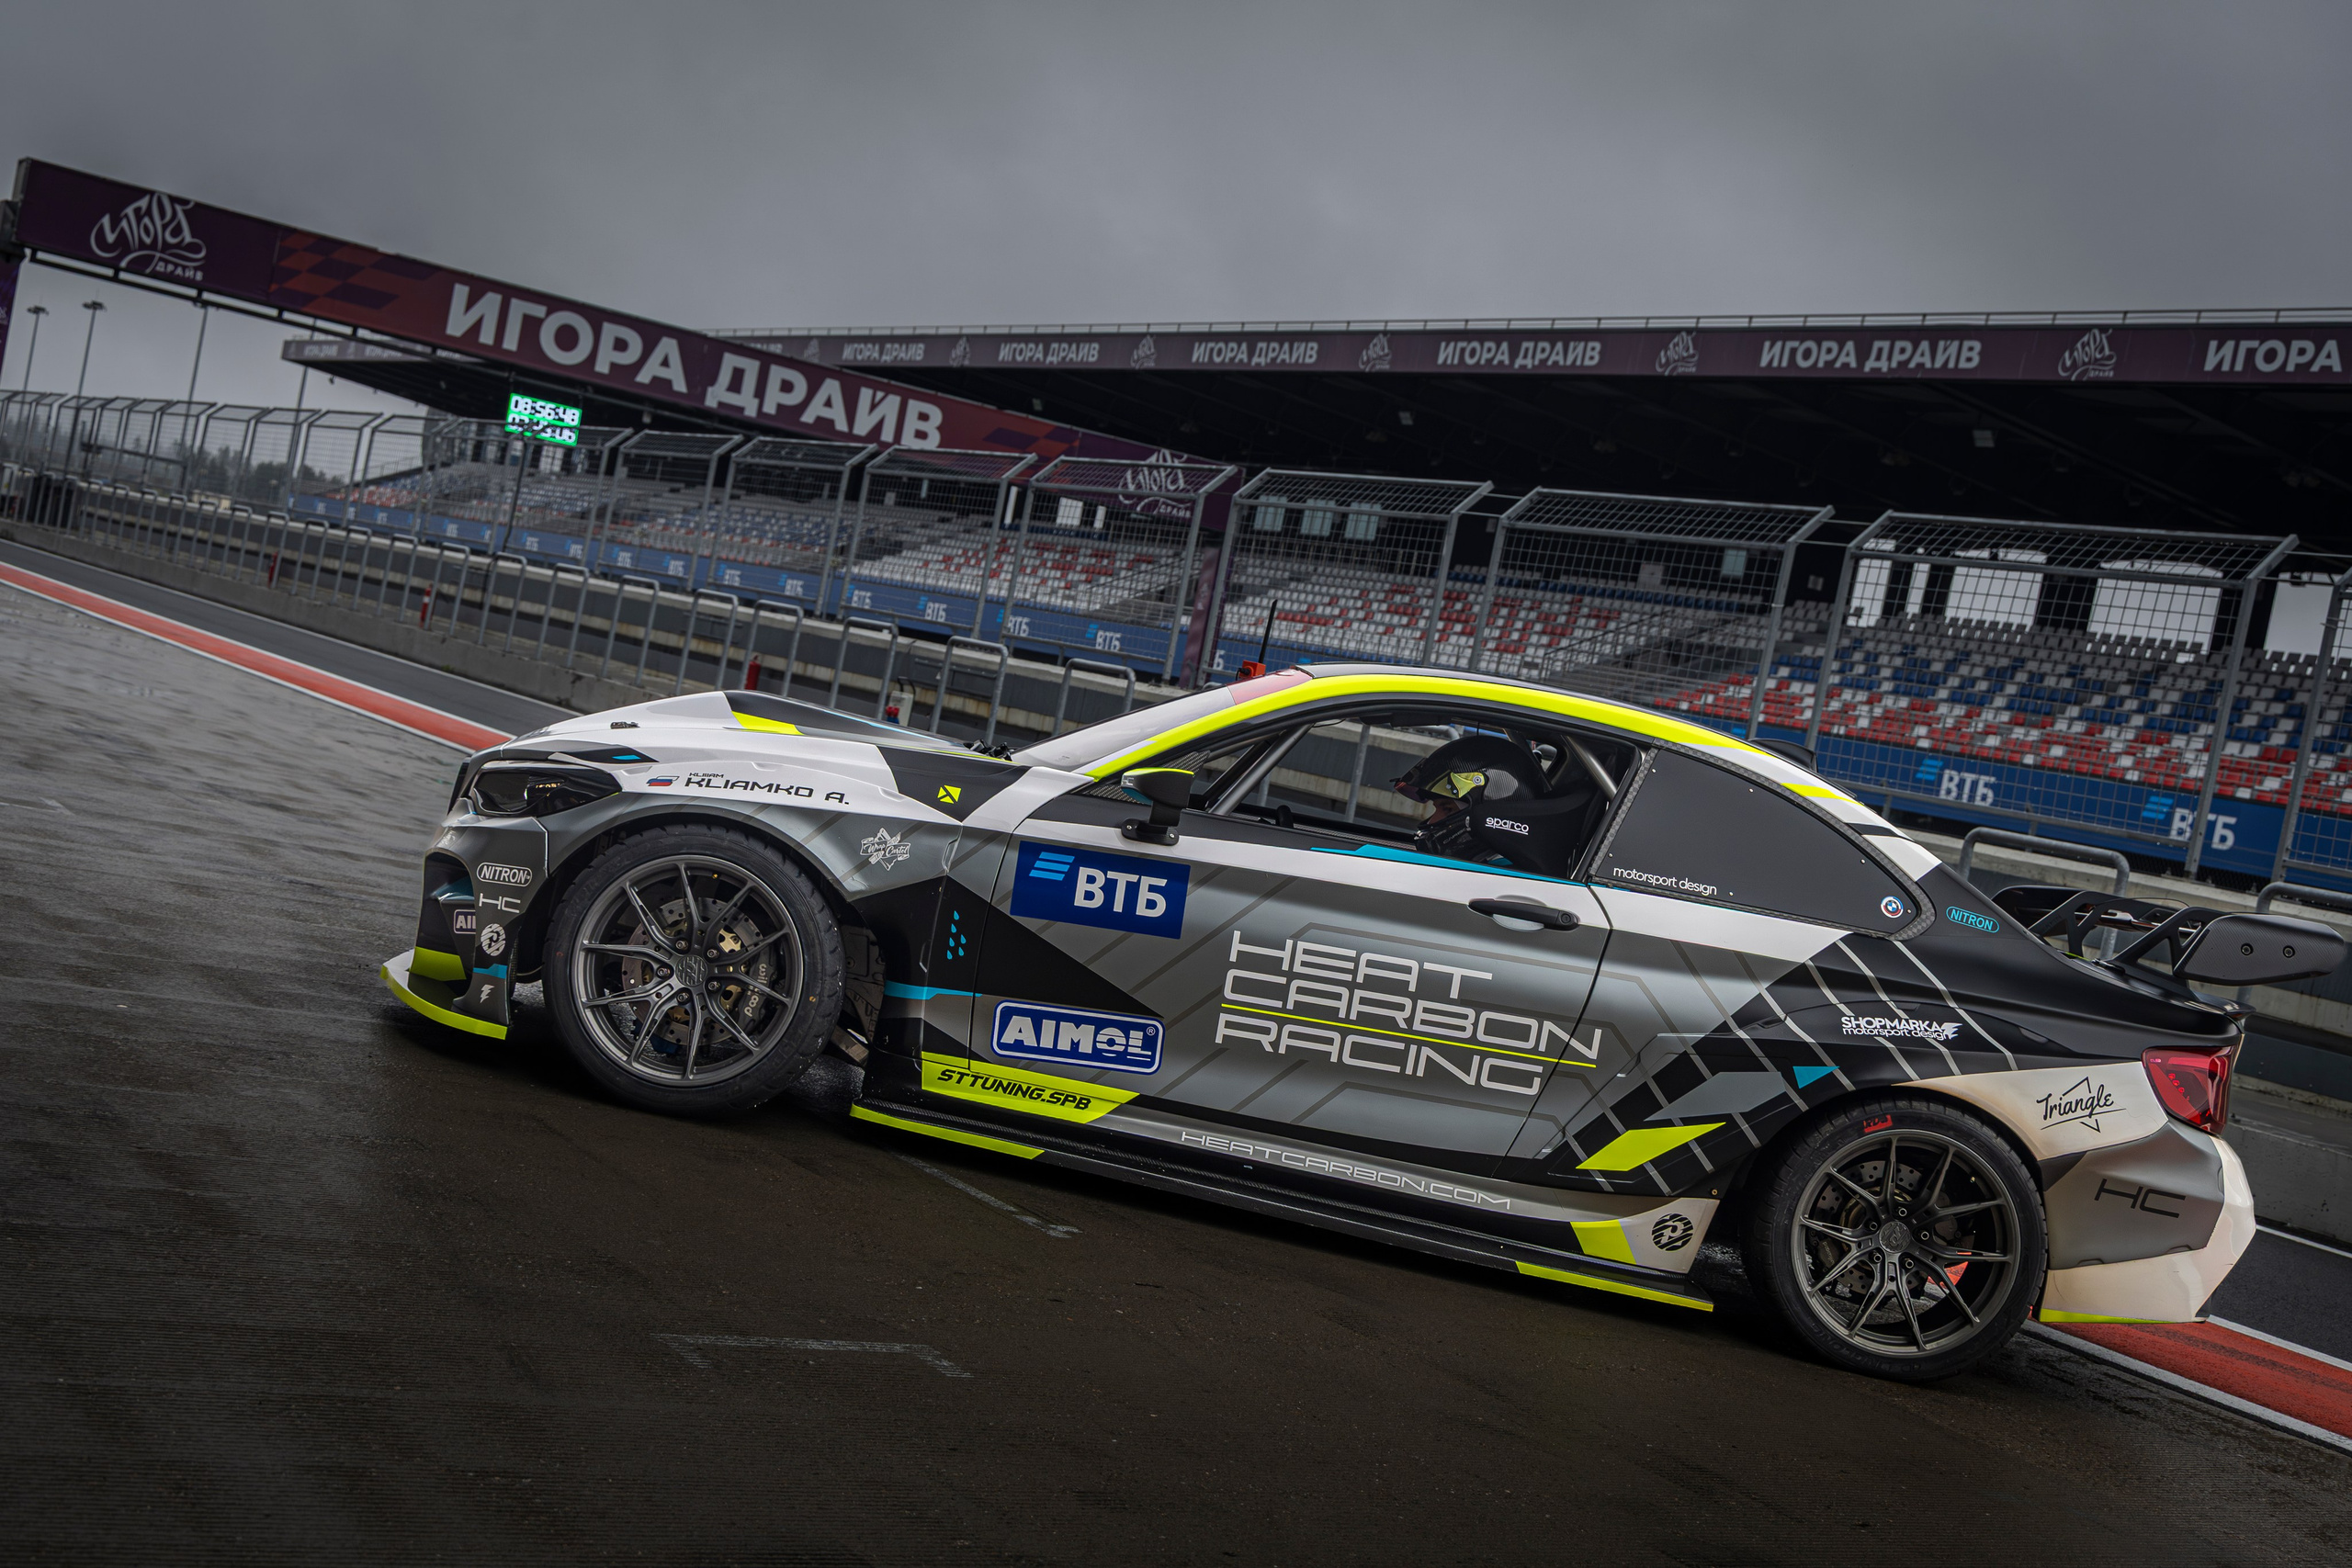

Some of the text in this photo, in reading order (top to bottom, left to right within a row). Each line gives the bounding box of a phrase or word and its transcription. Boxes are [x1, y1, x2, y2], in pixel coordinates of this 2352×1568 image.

[445, 283, 943, 448] ИГОРА ДРАЙВ
[842, 344, 879, 361] ИГОРА
[998, 343, 1044, 362] ИГОРА
[1192, 341, 1318, 367] ИГОРА ДРАЙВ
[1437, 341, 1601, 369] ИГОРА ДРАЙВ
[1759, 340, 1981, 372] ИГОРА ДРАЙВ
[2204, 339, 2342, 372] ИГОРА
[510, 395, 581, 426] 08:56:48
[925, 602, 946, 623] ВТБ
[1095, 629, 1122, 652] ВТБ
[684, 777, 850, 806] KLIAMKO A.
[1939, 769, 1996, 807] ВТБ
[1486, 816, 1530, 835] sparco
[481, 864, 528, 885] NITRON
[1613, 866, 1717, 897] motorsport design
[479, 892, 521, 914] HC
[1074, 866, 1168, 918] ВТБ
[1951, 908, 1994, 931] NITRON
[1229, 930, 1493, 999] HEAT
[1224, 968, 1602, 1060] CARBON
[1841, 1016, 1943, 1032] SHOPMARKA
[1842, 1026, 1911, 1038] motorsport
[1215, 1013, 1544, 1096] RACING
[937, 1068, 1091, 1111] STTUNING.SPB
[2036, 1084, 2115, 1121] Triangle
[1181, 1131, 1511, 1211] HEATCARBON.COM
[2094, 1178, 2187, 1219] HC
